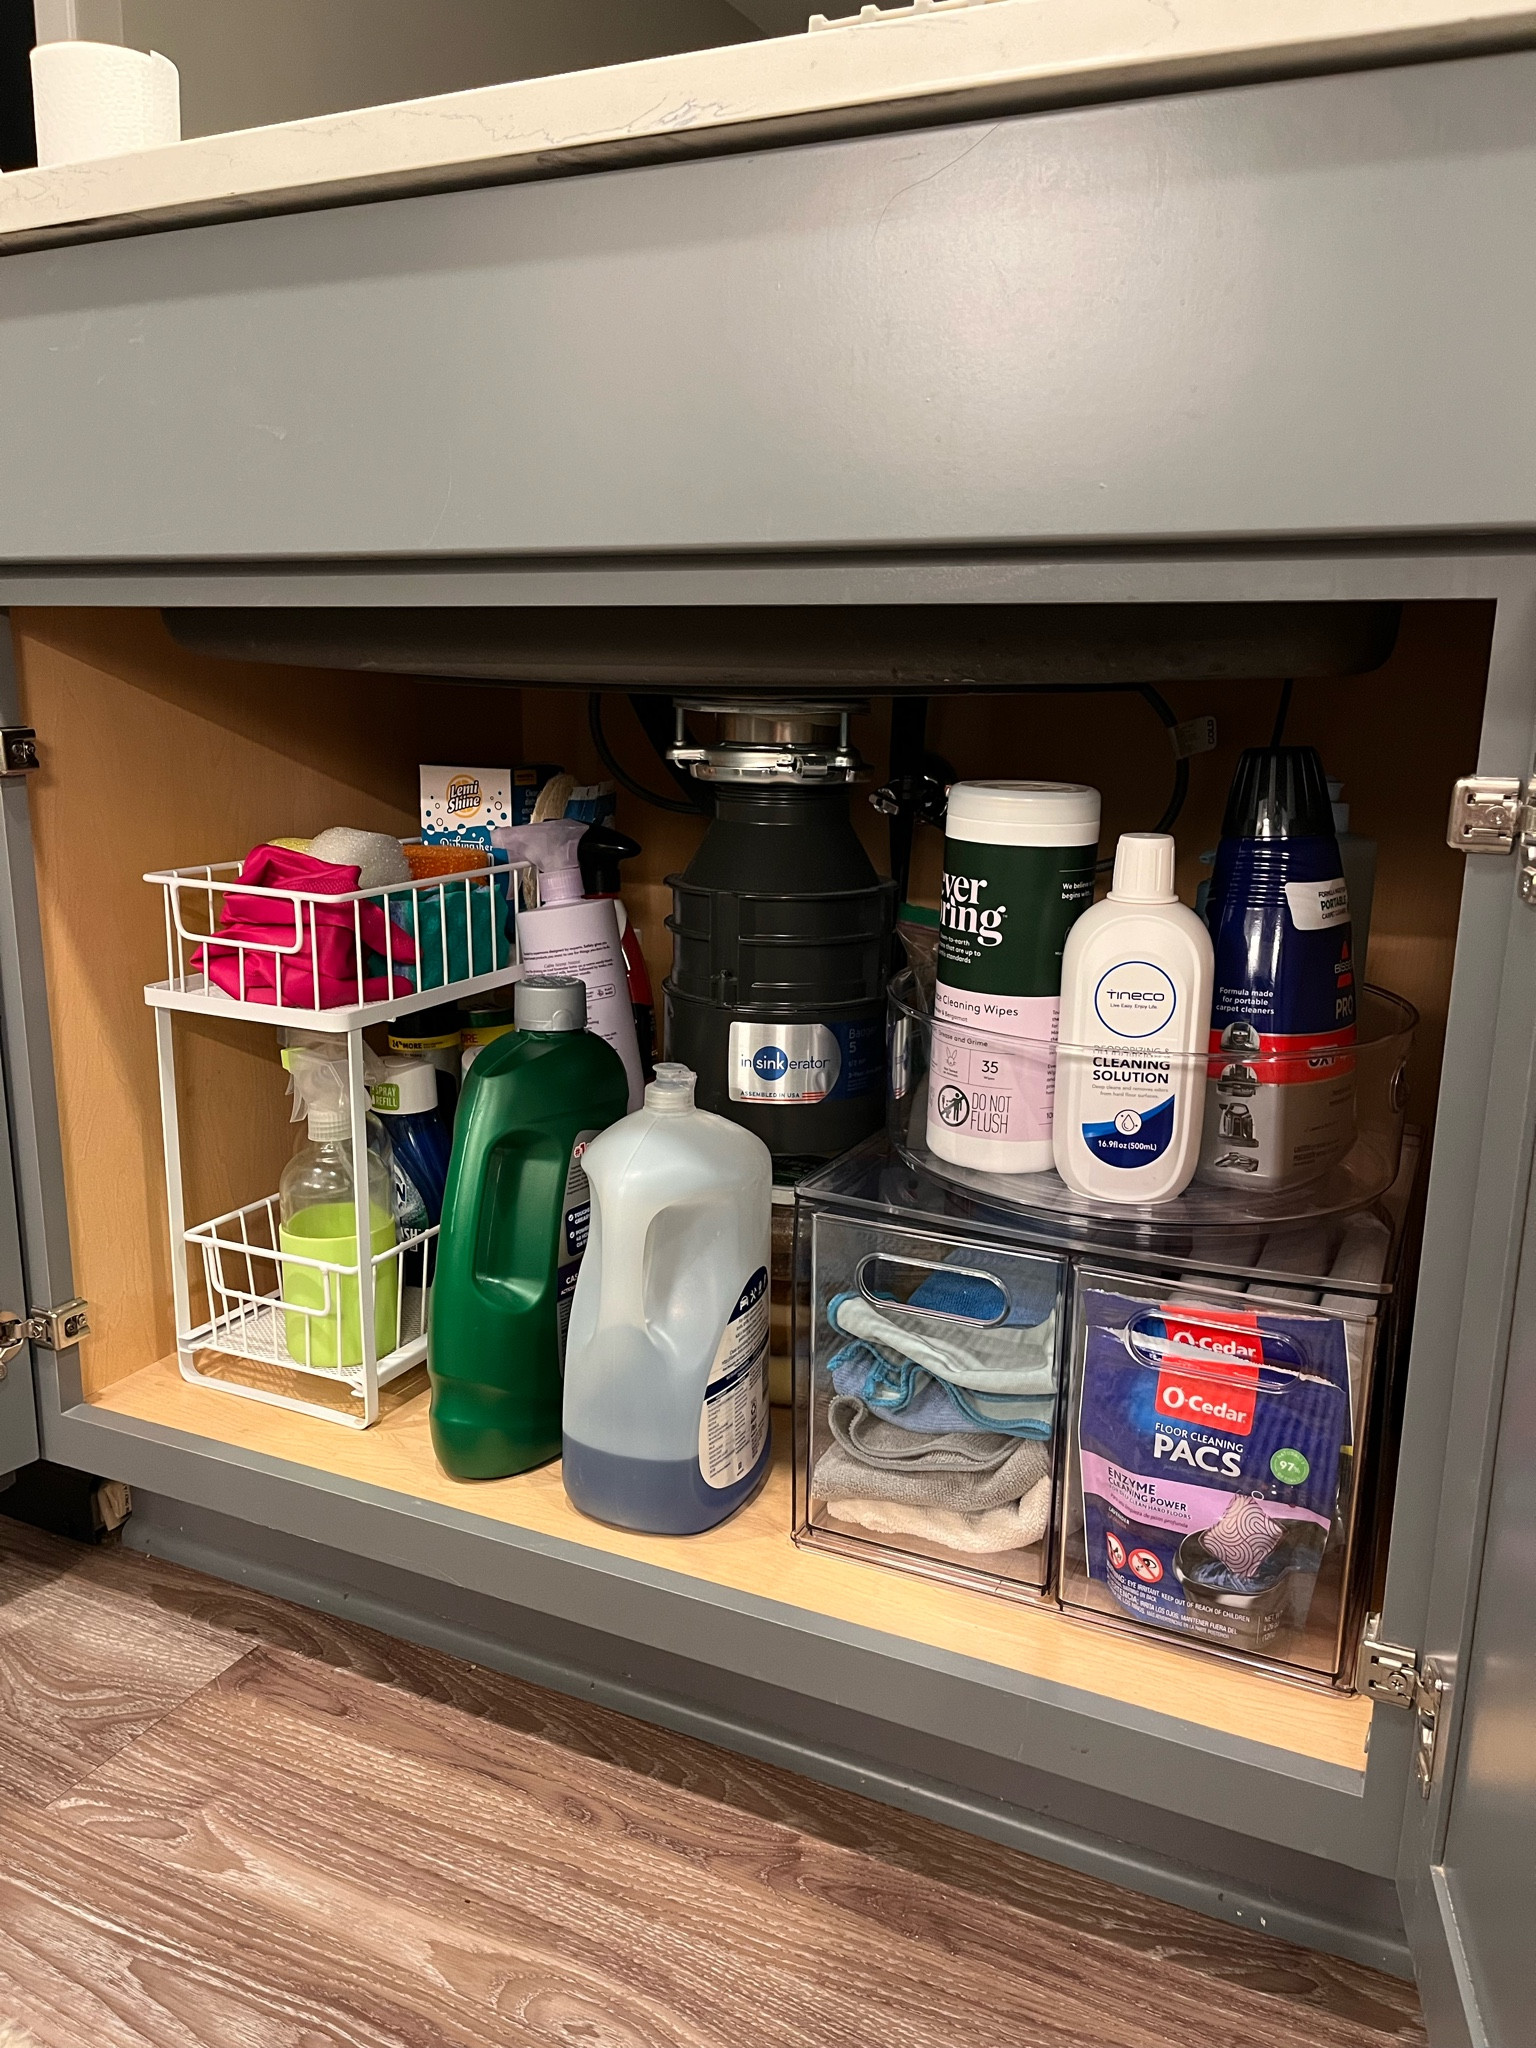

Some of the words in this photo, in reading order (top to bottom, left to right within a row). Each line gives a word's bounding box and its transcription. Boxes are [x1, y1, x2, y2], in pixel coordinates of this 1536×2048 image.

[450, 780, 479, 798] Lemi
[447, 796, 481, 814] Shine
[1062, 882, 1073, 890] We
[1061, 892, 1081, 900] begins
[940, 895, 1007, 947] ring
[1219, 986, 1250, 996] Formula
[1251, 989, 1275, 998] made
[1222, 995, 1233, 1003] for
[1234, 998, 1269, 1006] portable
[942, 995, 981, 1016] Cleaning
[984, 1003, 1019, 1018] Wipes
[1215, 1004, 1239, 1013] carpet
[1240, 1006, 1275, 1015] cleaners
[1335, 993, 1354, 1021] PRO
[966, 1037, 989, 1048] Grime
[981, 1059, 1000, 1075] 35
[1092, 1056, 1171, 1071] CLEANING
[1092, 1069, 1169, 1084] SOLUTION
[375, 1086, 396, 1096] SPRAY
[971, 1092, 987, 1111] DO
[989, 1094, 1013, 1114] NOT
[970, 1110, 1010, 1135] FLUSH
[1127, 1142, 1157, 1151] (500mL)
[1162, 1386, 1247, 1424] O-Cedar
[1155, 1422, 1188, 1439] FLOOR
[1190, 1432, 1244, 1453] CLEANING
[1153, 1432, 1242, 1478] PACS
[1108, 1466, 1156, 1496] ENZYME
[1108, 1477, 1148, 1503] CLEANING
[1150, 1497, 1187, 1512] POWER
[1166, 1509, 1191, 1520] FLOORS
[1127, 1579, 1137, 1589] EYE
[1161, 1592, 1175, 1603] KEEP
[1174, 1598, 1186, 1607] OUT
[1186, 1601, 1195, 1609] OF
[1194, 1603, 1214, 1614] REACH
[1214, 1608, 1222, 1616] OF
[1222, 1610, 1251, 1623] CHILDREN
[1155, 1606, 1166, 1615] LOS
[1180, 1614, 1210, 1628] MANTENER
[1209, 1622, 1227, 1632] FUERA
[1227, 1626, 1238, 1635] DEL
